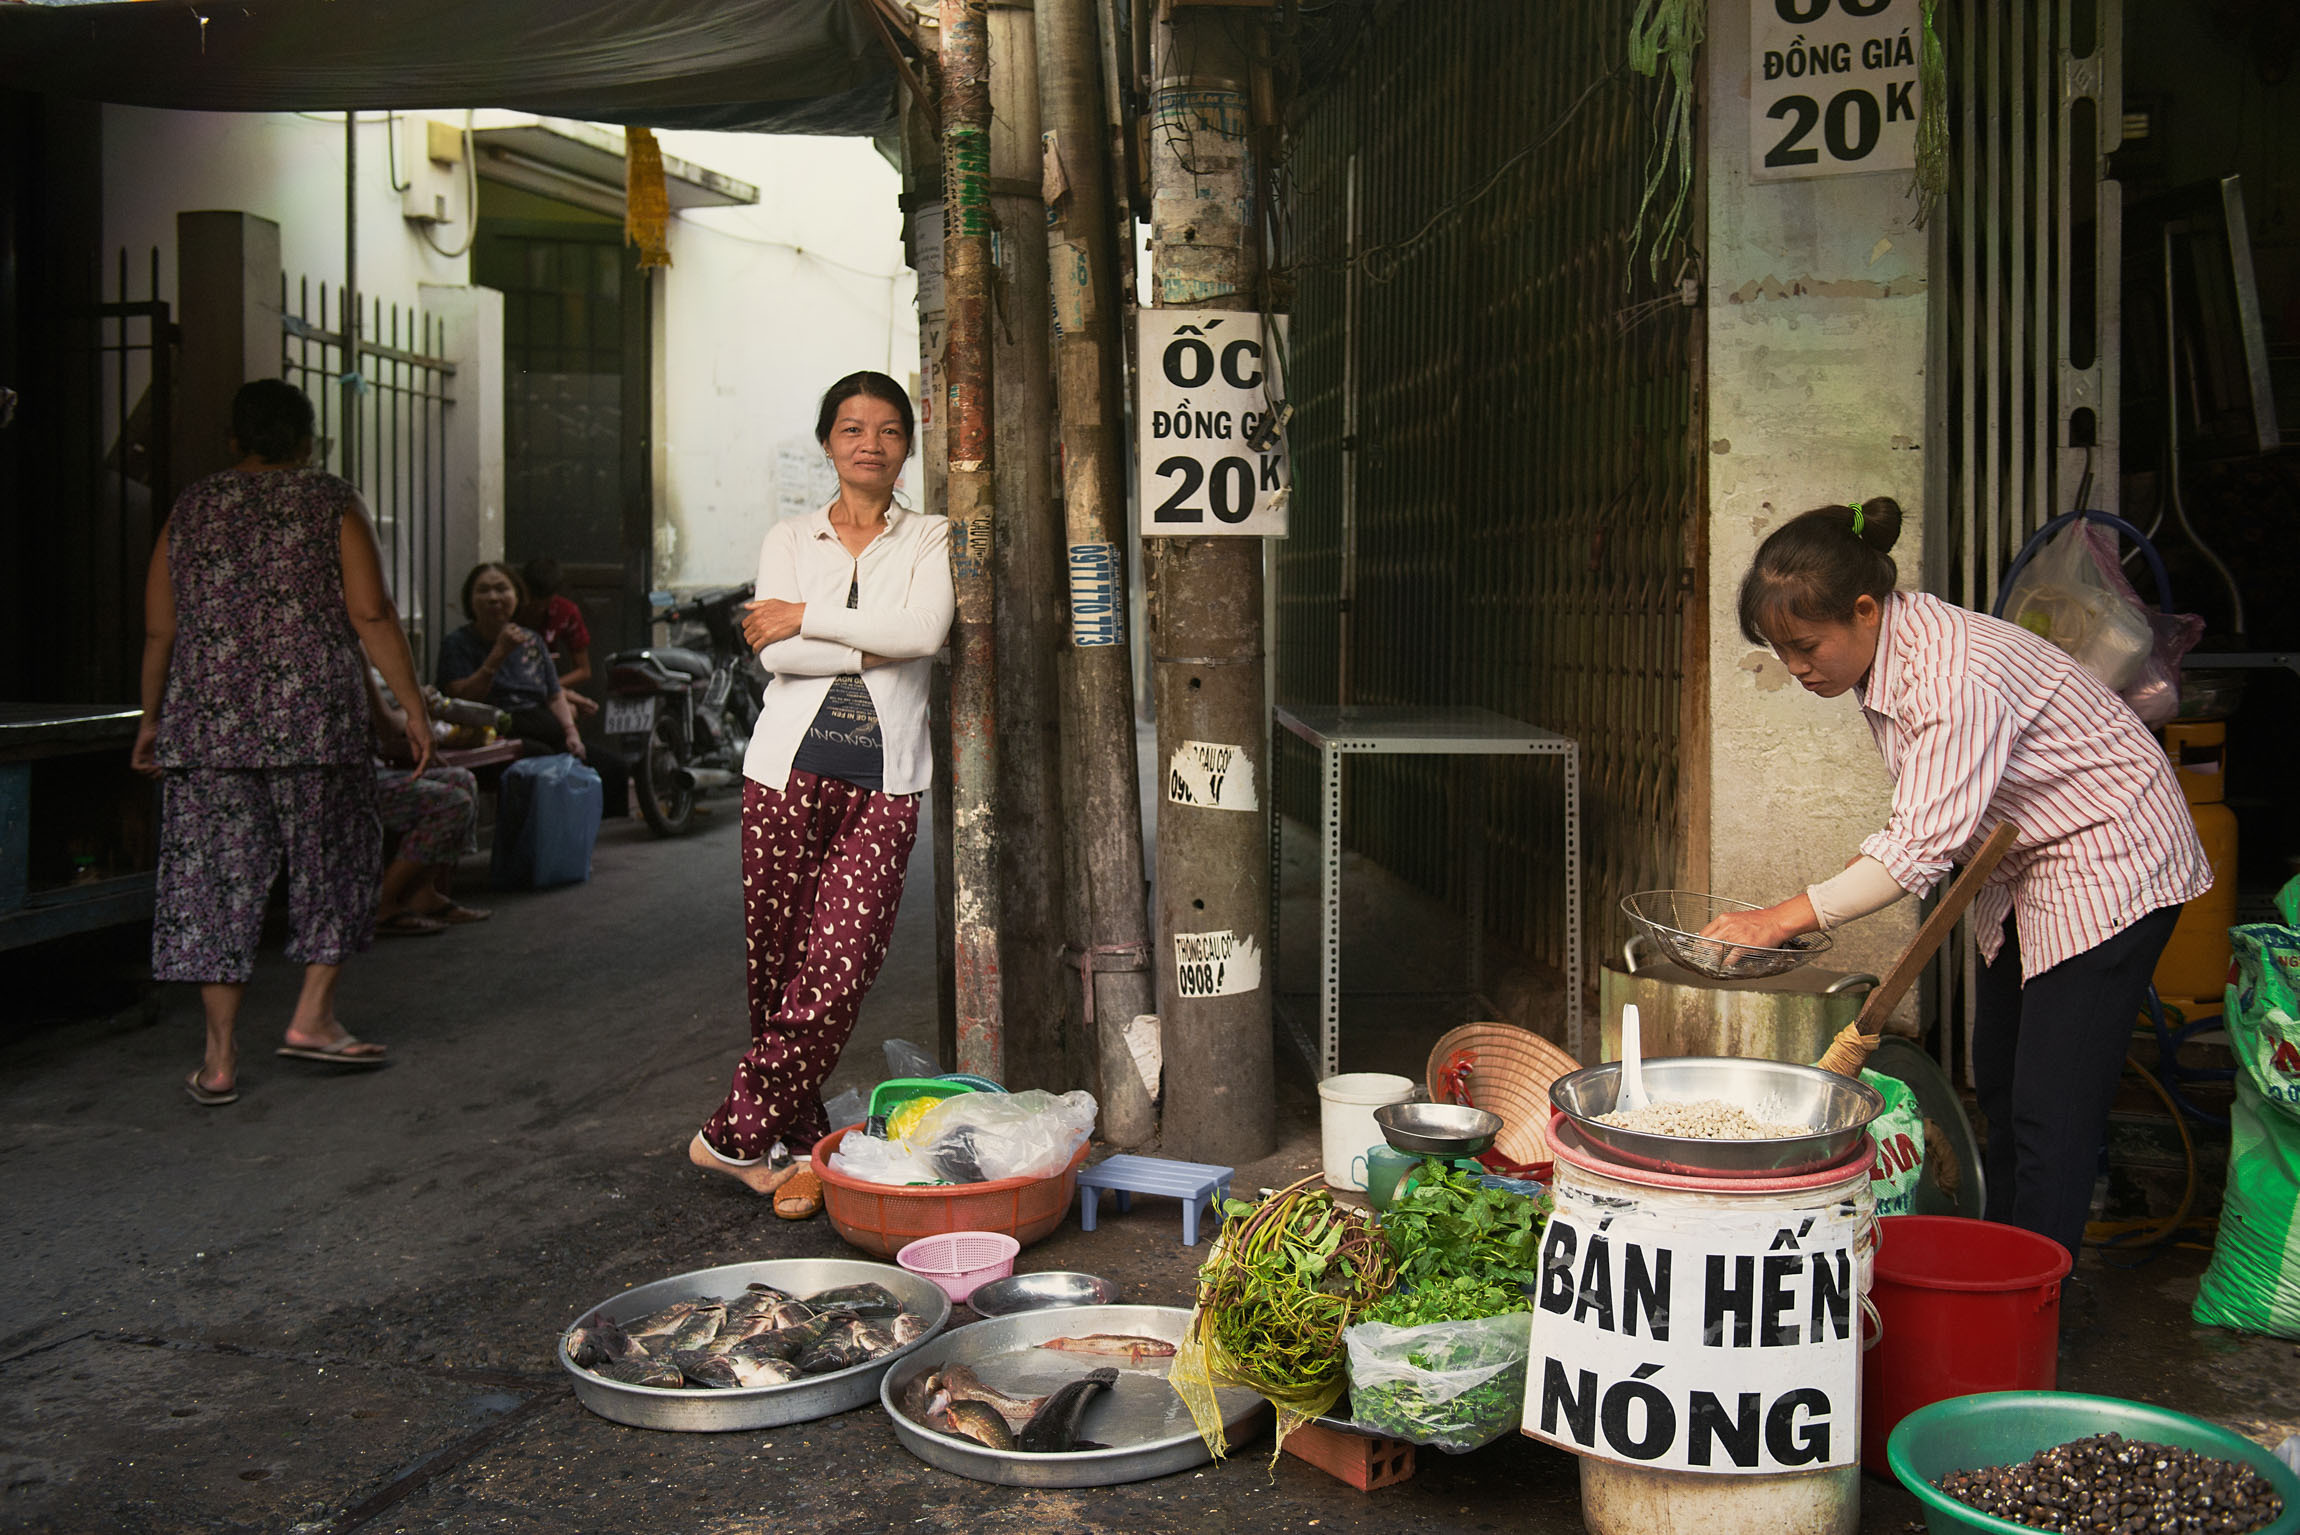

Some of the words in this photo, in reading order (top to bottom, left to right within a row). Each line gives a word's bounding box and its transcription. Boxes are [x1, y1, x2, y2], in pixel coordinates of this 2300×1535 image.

[1763, 34, 1851, 81] ĐỒNG
[1862, 27, 1914, 70] GIÁ
[1162, 319, 1265, 389] ỐC
[1152, 398, 1232, 439] ĐỒNG
[1539, 1212, 1673, 1343] BÁN
[1703, 1216, 1851, 1348] HẾN
[1540, 1356, 1832, 1468] NÓNG
